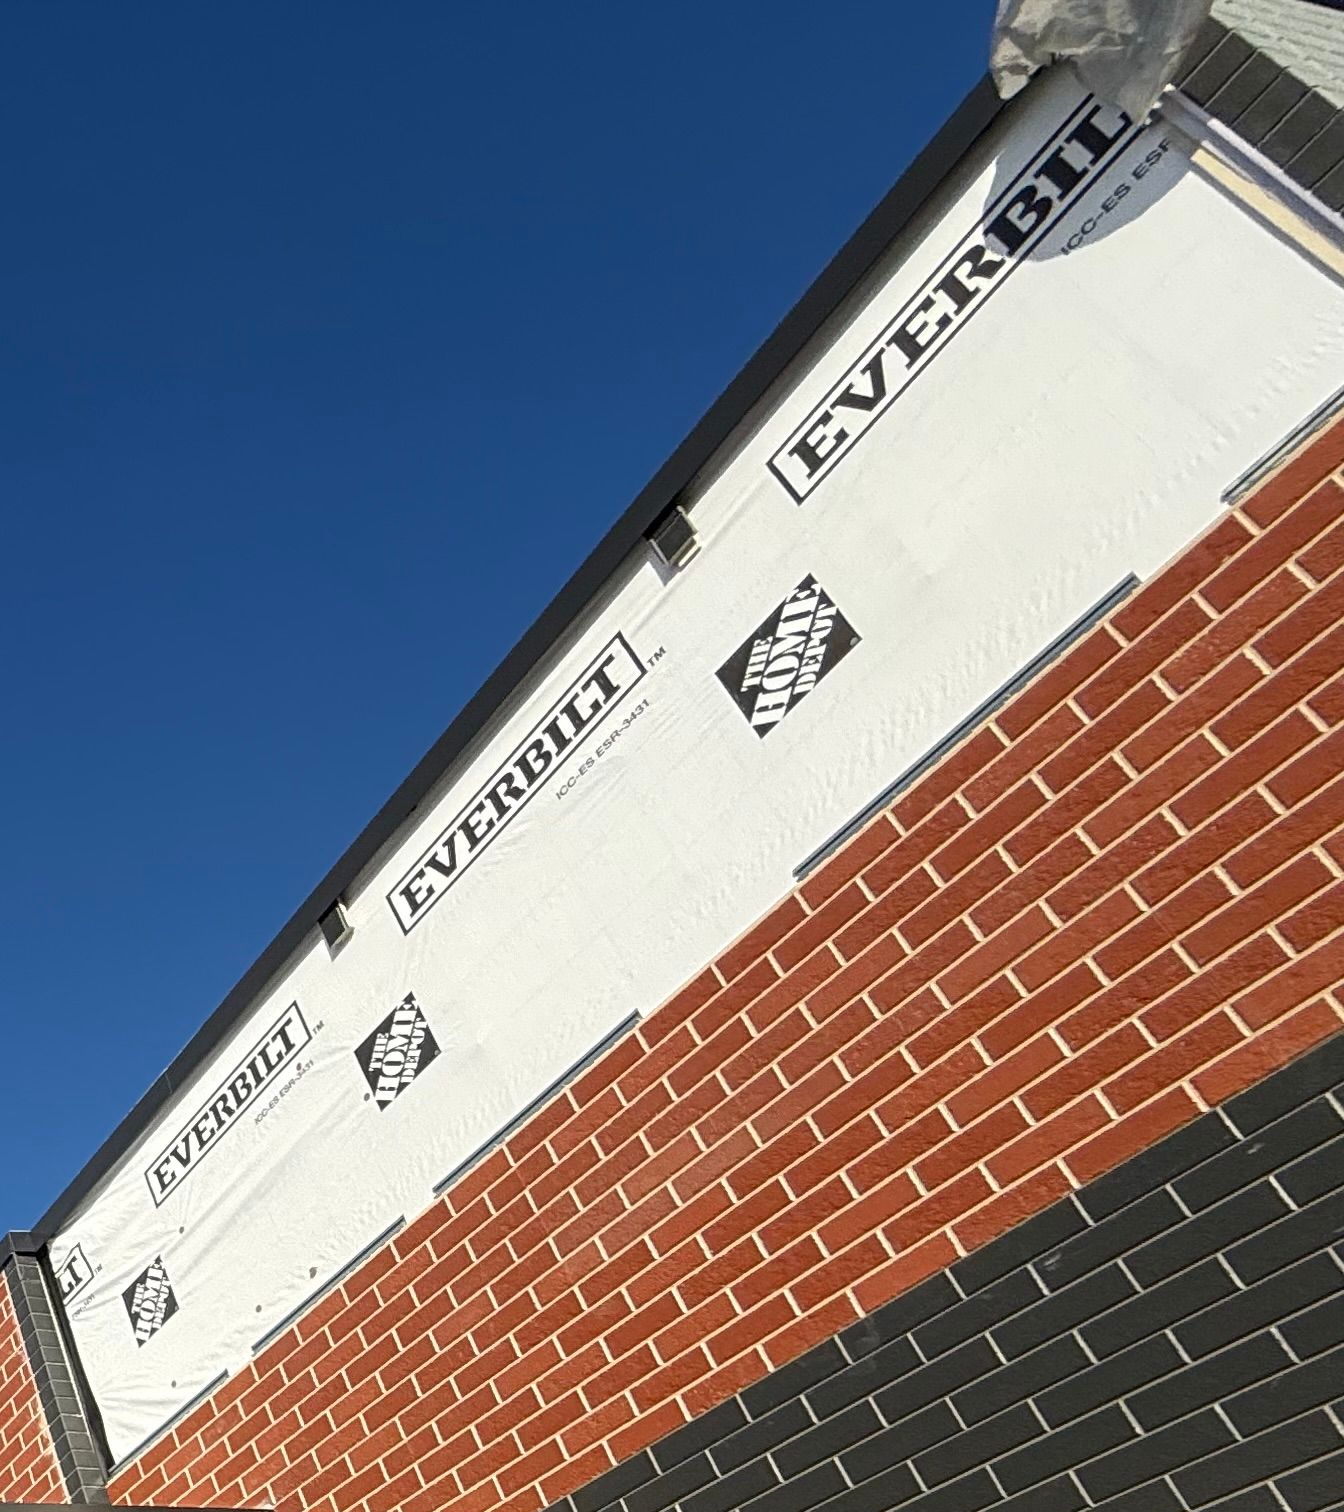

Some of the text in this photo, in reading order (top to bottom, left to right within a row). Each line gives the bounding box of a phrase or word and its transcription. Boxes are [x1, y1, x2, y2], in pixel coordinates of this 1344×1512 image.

[1061, 183, 1131, 256] ICC-ES
[787, 104, 1133, 480] EVERBIL
[740, 636, 774, 692] THE
[750, 583, 822, 726] HOME
[792, 603, 838, 695] DEPOT
[398, 653, 621, 918] EVERBILT
[555, 699, 650, 800] ICC-ES ESR-3431
[368, 1032, 389, 1071] THE
[375, 1001, 418, 1101] HOME
[400, 1017, 429, 1083] DEPOT
[153, 1017, 296, 1194] EVERBILT
[131, 1282, 145, 1314] THE
[135, 1262, 164, 1340] HOME
